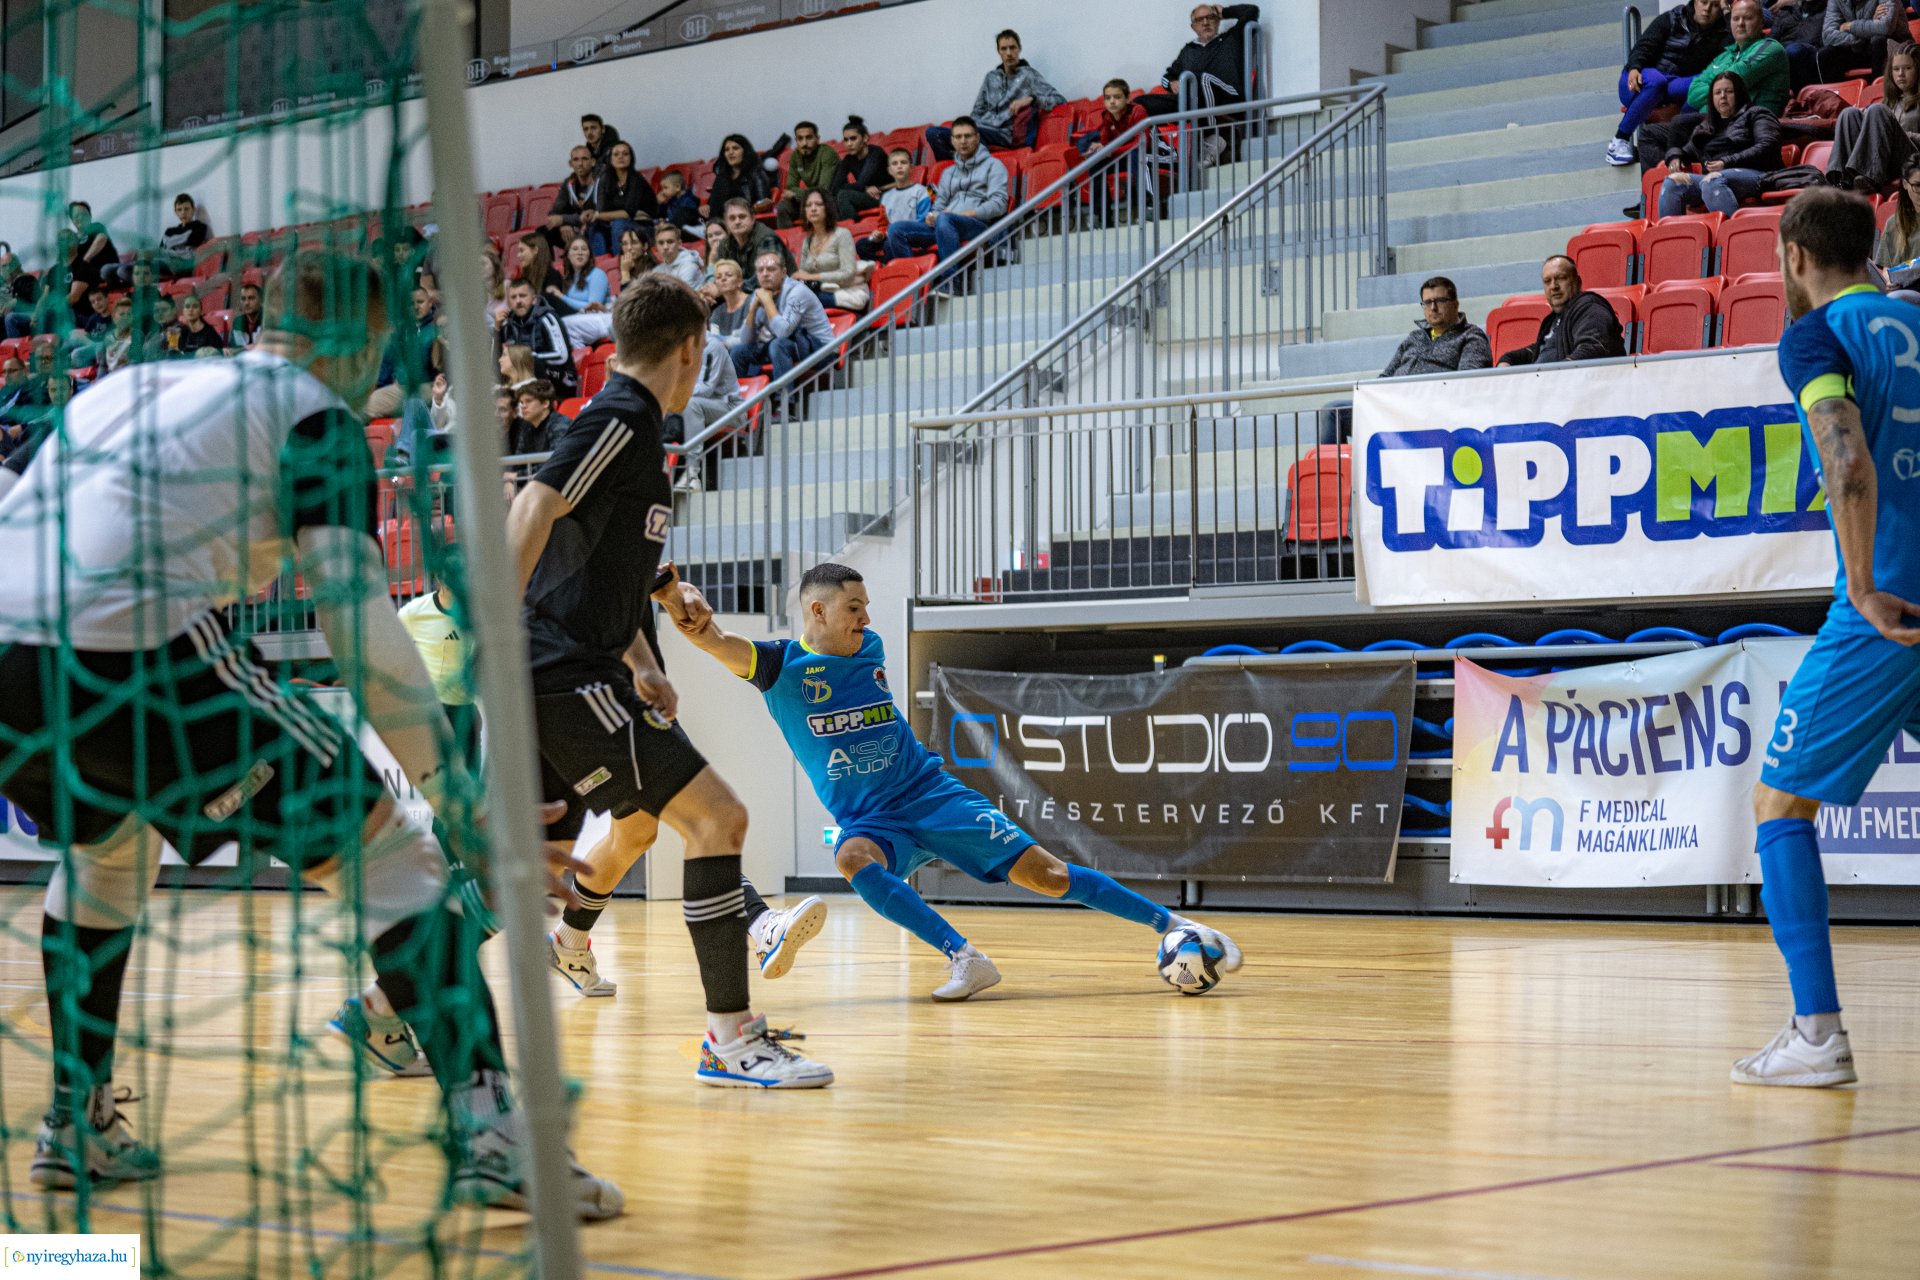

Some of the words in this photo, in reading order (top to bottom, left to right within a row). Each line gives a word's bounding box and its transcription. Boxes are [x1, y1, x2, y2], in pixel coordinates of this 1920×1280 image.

[684, 22, 708, 40] BH
[574, 42, 596, 61] BH
[466, 62, 486, 82] BH
[1379, 421, 1828, 536] TiPPMI
[805, 666, 826, 675] JAKO
[1287, 709, 1399, 773] 90
[1491, 693, 1530, 774] A
[1541, 680, 1752, 777] PÁCIENS
[1771, 708, 1798, 753] 3
[999, 794, 1285, 825] ÍTÉSZTERVEZŐ
[1319, 803, 1390, 824] KFT
[1579, 799, 1592, 823] F
[1596, 798, 1668, 824] MEDICAL
[1813, 806, 1920, 839] WW.FMED
[1002, 831, 1020, 845] JAKO
[1576, 824, 1699, 853] MAGÁNKLINIKA
